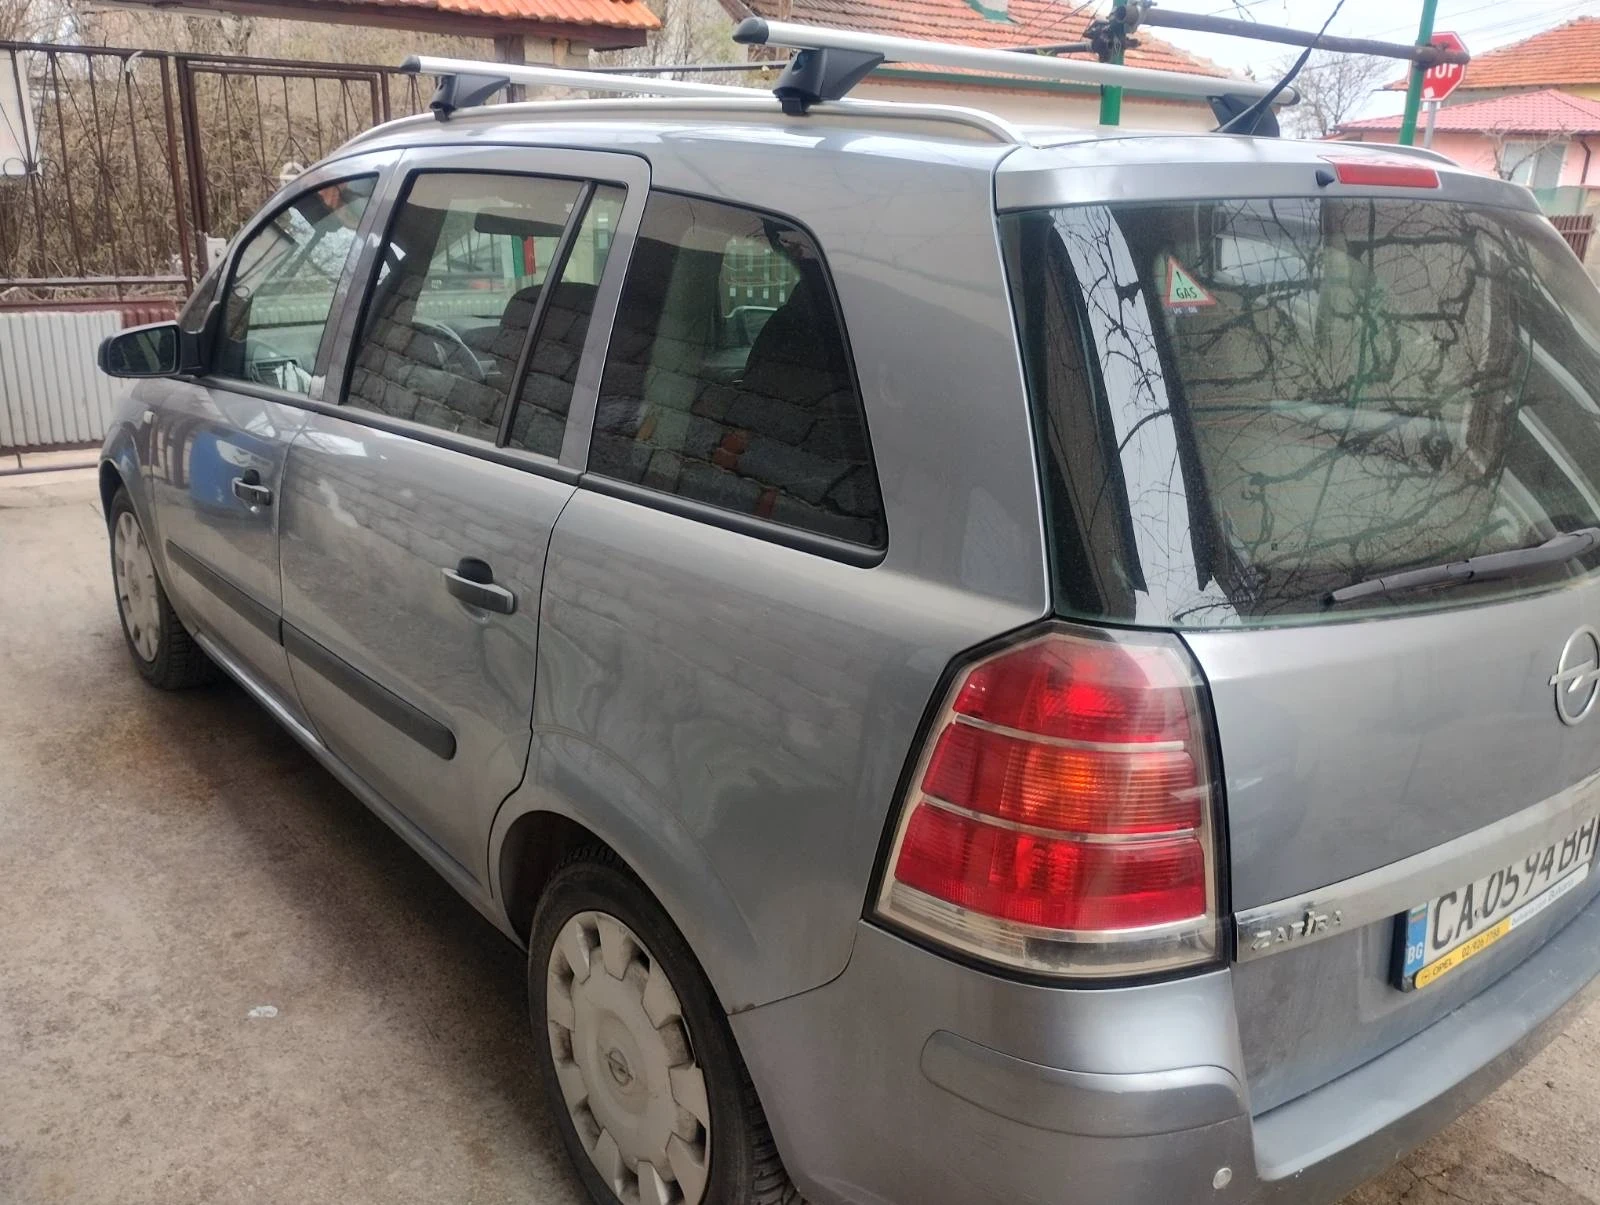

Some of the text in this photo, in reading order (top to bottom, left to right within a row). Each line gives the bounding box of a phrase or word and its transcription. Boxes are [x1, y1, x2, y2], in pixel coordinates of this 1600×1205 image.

[1176, 287, 1198, 299] GAS
[1250, 910, 1343, 951] ZAFIRA
[1406, 942, 1424, 965] BG
